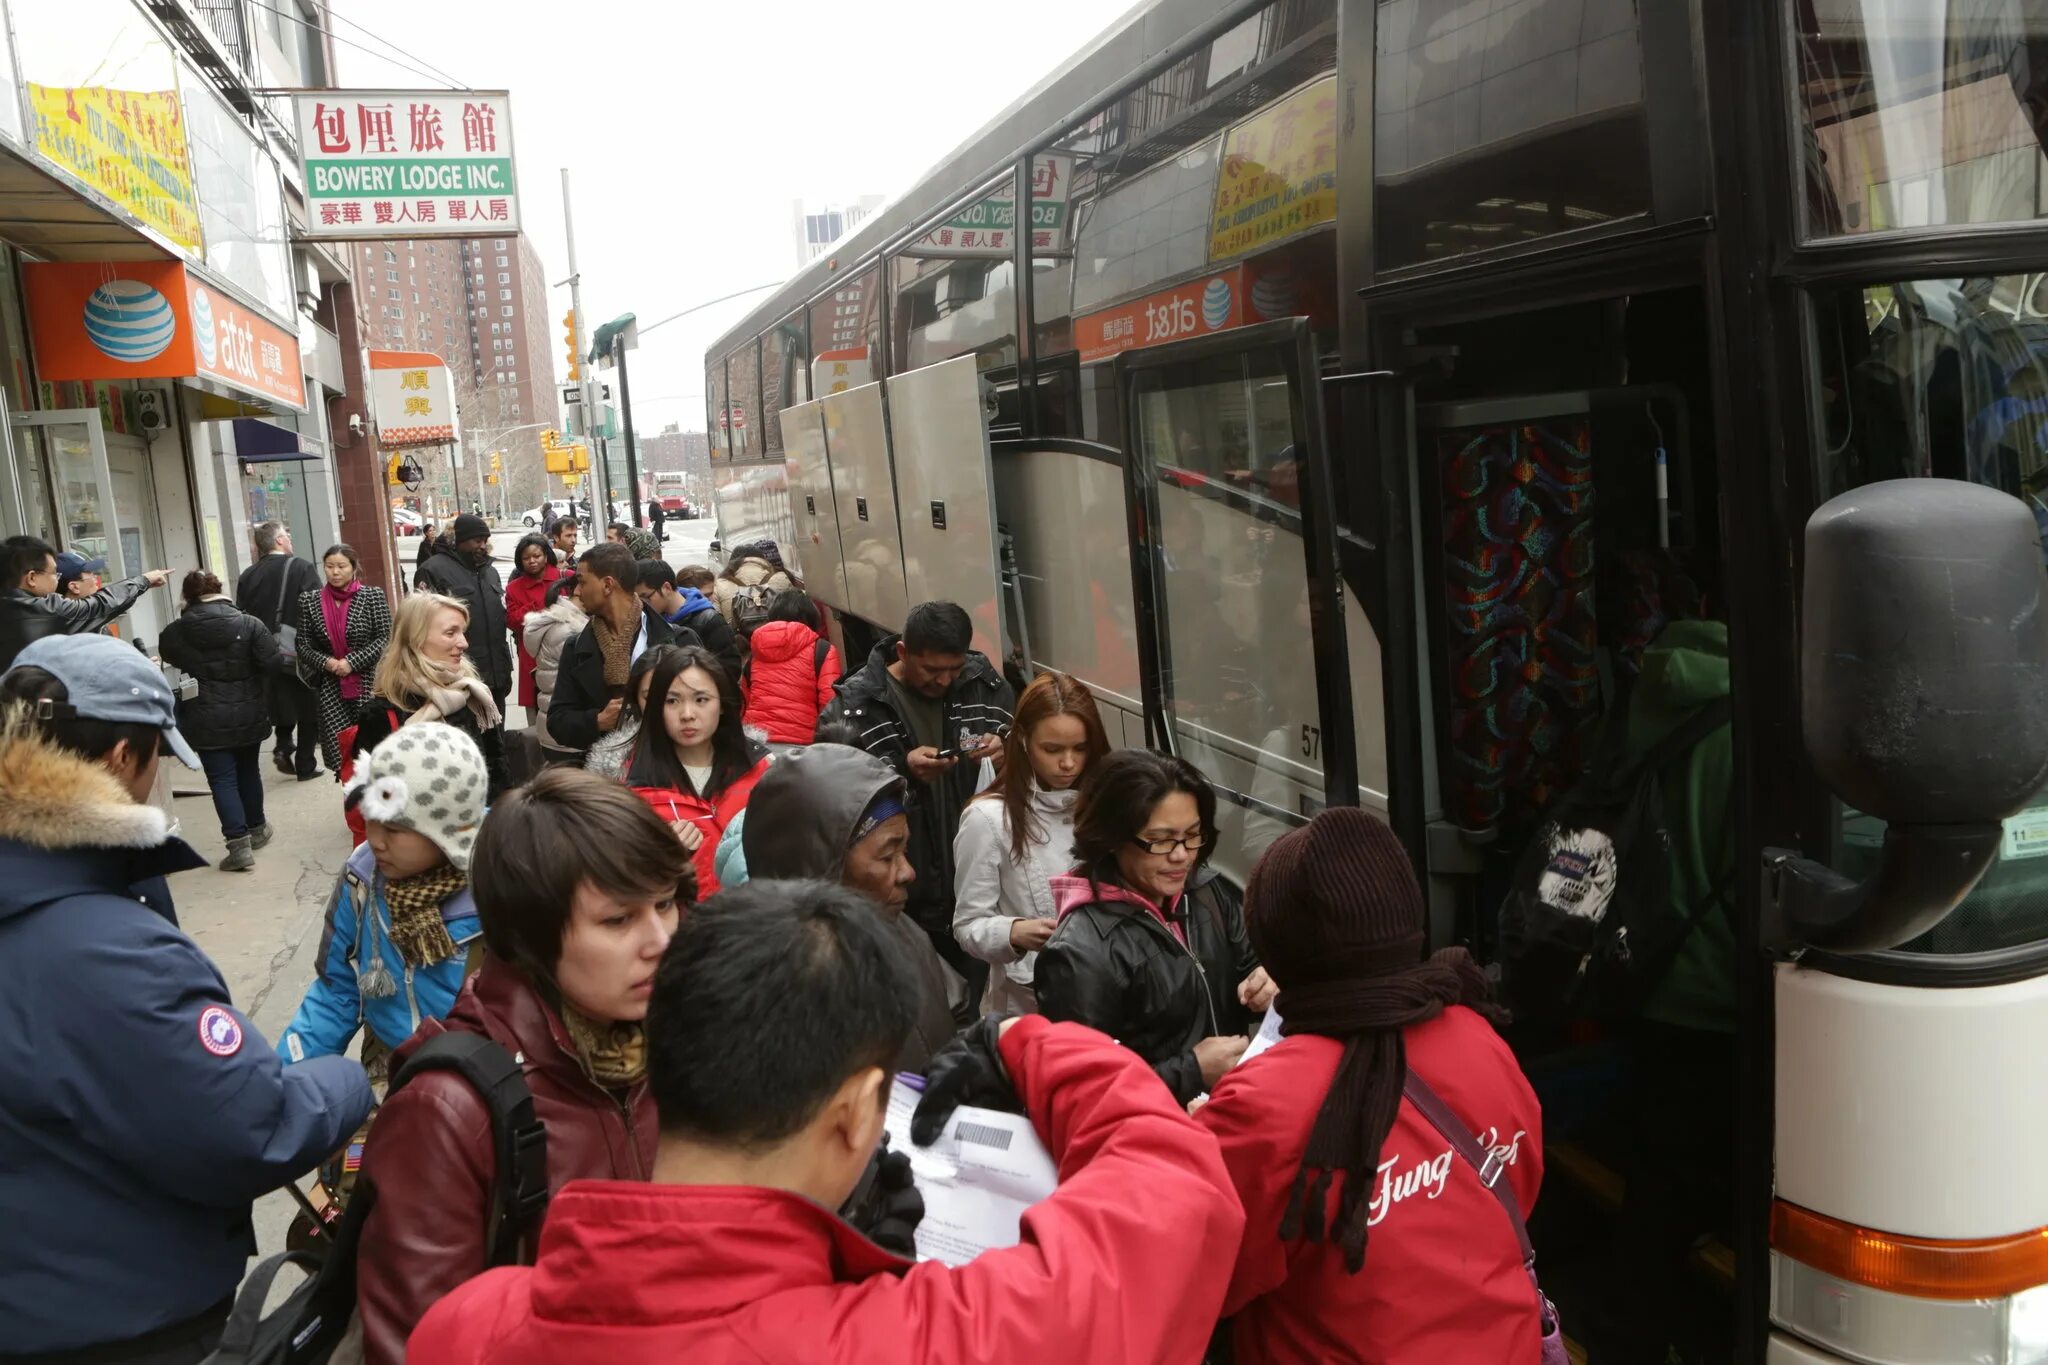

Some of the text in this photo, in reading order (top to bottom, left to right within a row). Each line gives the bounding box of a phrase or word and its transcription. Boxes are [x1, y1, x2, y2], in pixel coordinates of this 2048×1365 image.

[312, 102, 496, 154] 包厘旅館
[315, 165, 505, 191] BOWERY LODGE INC.
[319, 199, 508, 225] 豪華 雙人房 單人房
[220, 311, 258, 382] at&t
[1302, 723, 1320, 760] 57
[1367, 1150, 1453, 1227] Fung
